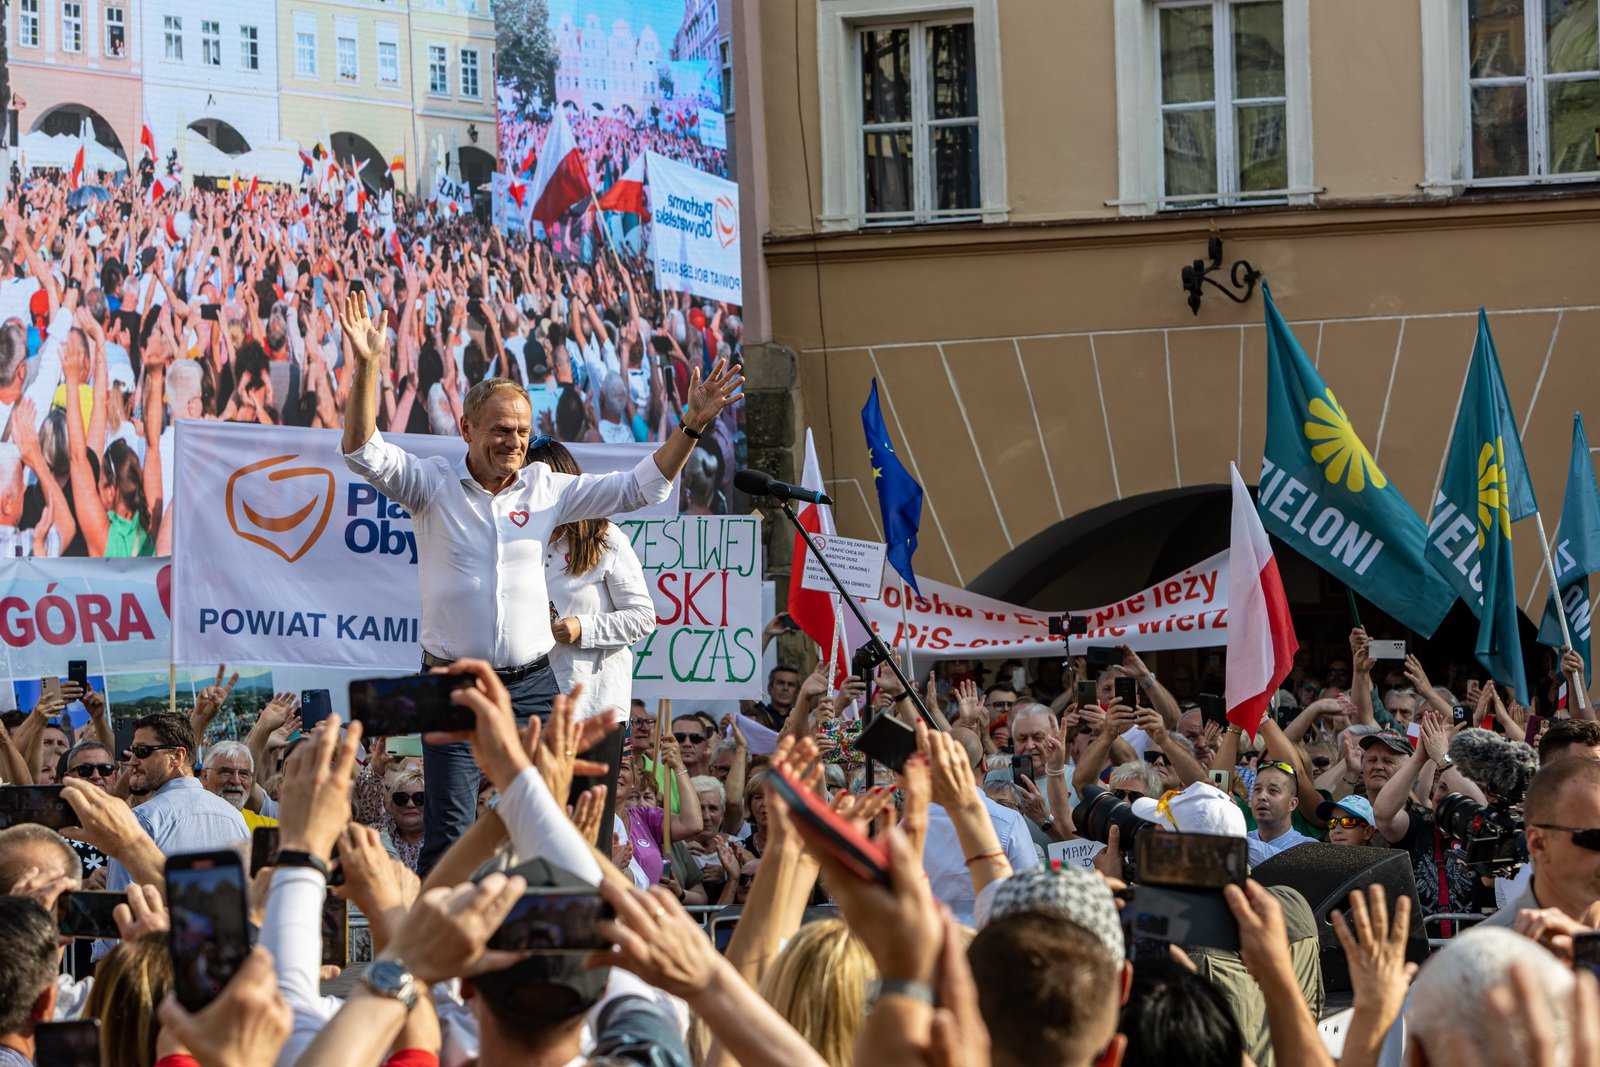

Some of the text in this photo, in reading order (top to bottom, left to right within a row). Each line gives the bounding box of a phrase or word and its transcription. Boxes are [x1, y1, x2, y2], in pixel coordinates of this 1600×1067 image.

[618, 516, 756, 577] ZĘŚLIWEJ
[1152, 570, 1218, 608] leży
[0, 582, 156, 648] GÓRA
[199, 608, 418, 643] POWIAT KAMI
[669, 627, 756, 684] CZAS
[1062, 844, 1094, 860] MAMY
